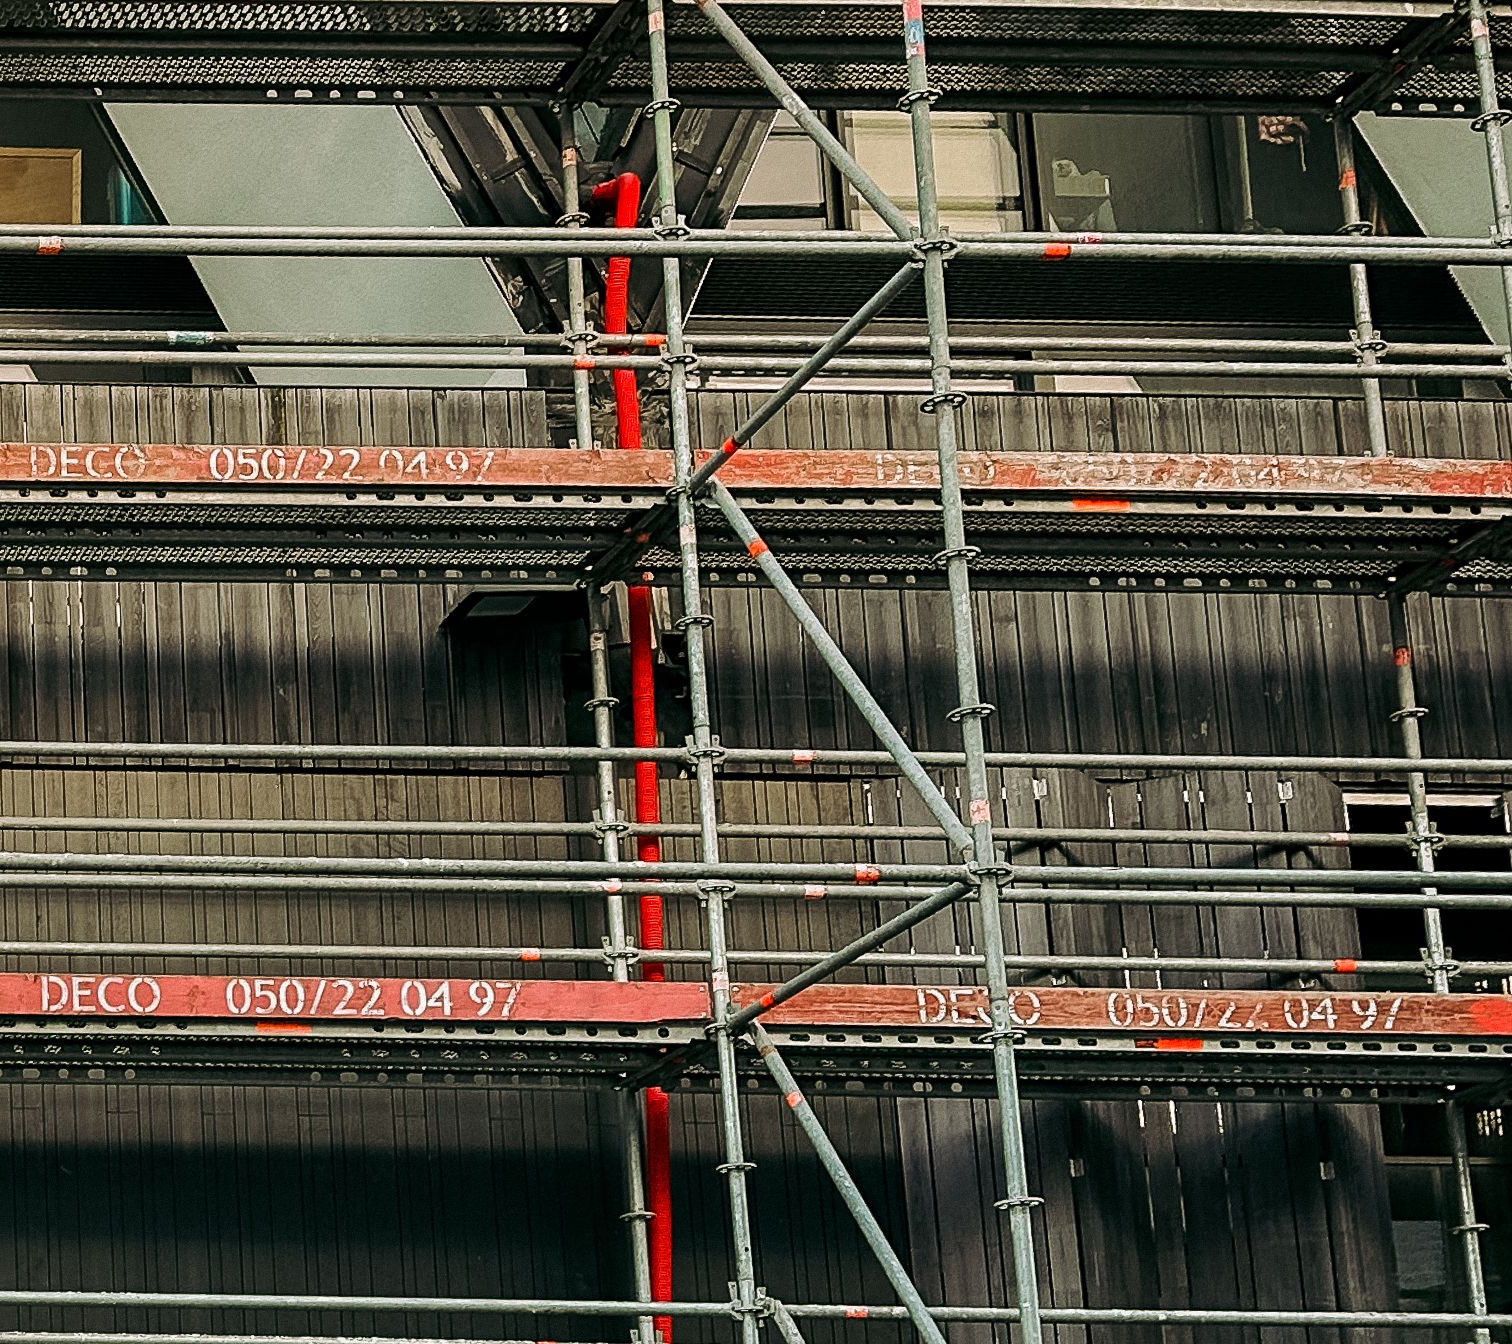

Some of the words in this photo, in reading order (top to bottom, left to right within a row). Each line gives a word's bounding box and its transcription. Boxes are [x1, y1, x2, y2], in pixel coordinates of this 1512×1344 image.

[30, 446, 145, 480] DECO
[210, 447, 364, 482] 050/22
[378, 449, 430, 483] 04
[445, 450, 495, 484] 97
[876, 453, 995, 484] DEO
[41, 976, 162, 1014] DECO
[226, 978, 385, 1016] 050/22
[401, 979, 453, 1017] 04
[468, 980, 522, 1018] 97
[1283, 995, 1337, 1030] 04
[1351, 995, 1403, 1030] 97
